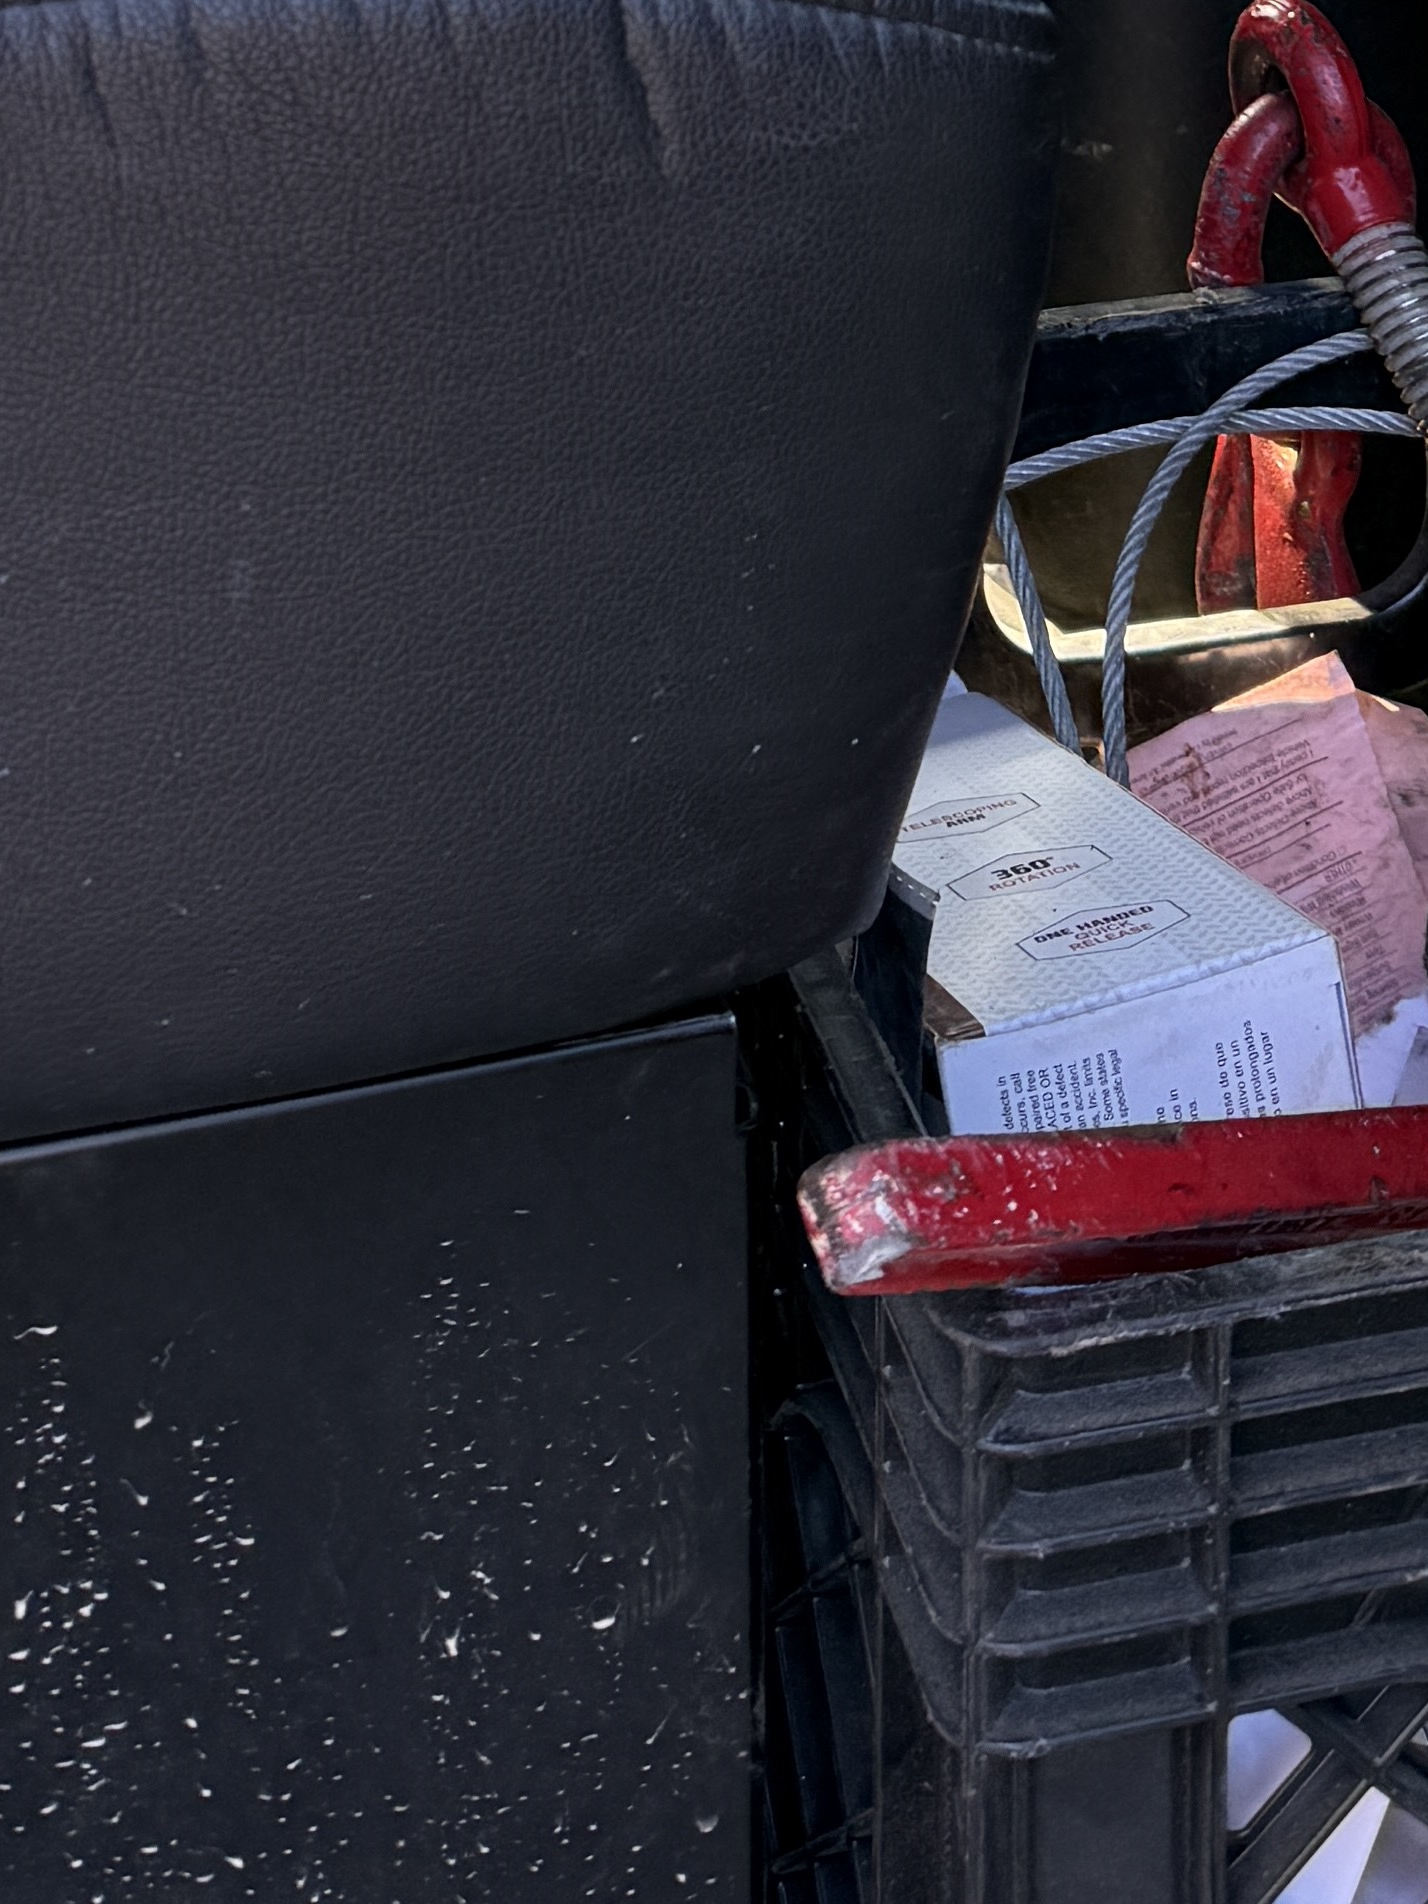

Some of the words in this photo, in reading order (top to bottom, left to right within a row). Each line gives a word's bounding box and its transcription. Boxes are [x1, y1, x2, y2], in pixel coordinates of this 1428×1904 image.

[902, 799, 1017, 833] TELESCOPING
[945, 813, 986, 828] ARM
[1293, 850, 1337, 877] Condition
[989, 862, 1080, 891] ROTATION
[1033, 928, 1074, 944] ONE
[1075, 905, 1154, 930] HANDED
[1073, 919, 1132, 941] QUICK
[1068, 922, 1155, 952] RELEASE
[1215, 1042, 1228, 1067] que
[1230, 1039, 1241, 1057] un
[1260, 1031, 1274, 1064] lugar
[1082, 1057, 1094, 1086] limits
[1095, 1052, 1109, 1086] states
[1107, 1049, 1122, 1076] legal
[1233, 1060, 1244, 1077] en
[1241, 1020, 1267, 1102] prolongados
[997, 1075, 1007, 1086] in
[1009, 1072, 1023, 1094] call
[1026, 1069, 1037, 1092] free
[1037, 1067, 1051, 1088] OR
[1052, 1063, 1067, 1098] defect
[1218, 1070, 1230, 1088] de
[1266, 1066, 1277, 1084] un
[1060, 1100, 1070, 1109] a
[1087, 1088, 1098, 1108] Inc.
[1101, 1087, 1115, 1121] Some
[1112, 1076, 1129, 1118] specific
[1169, 1088, 1179, 1101] in
[1270, 1086, 1280, 1104] en
[999, 1089, 1015, 1130] defects
[1059, 1111, 1072, 1123] of
